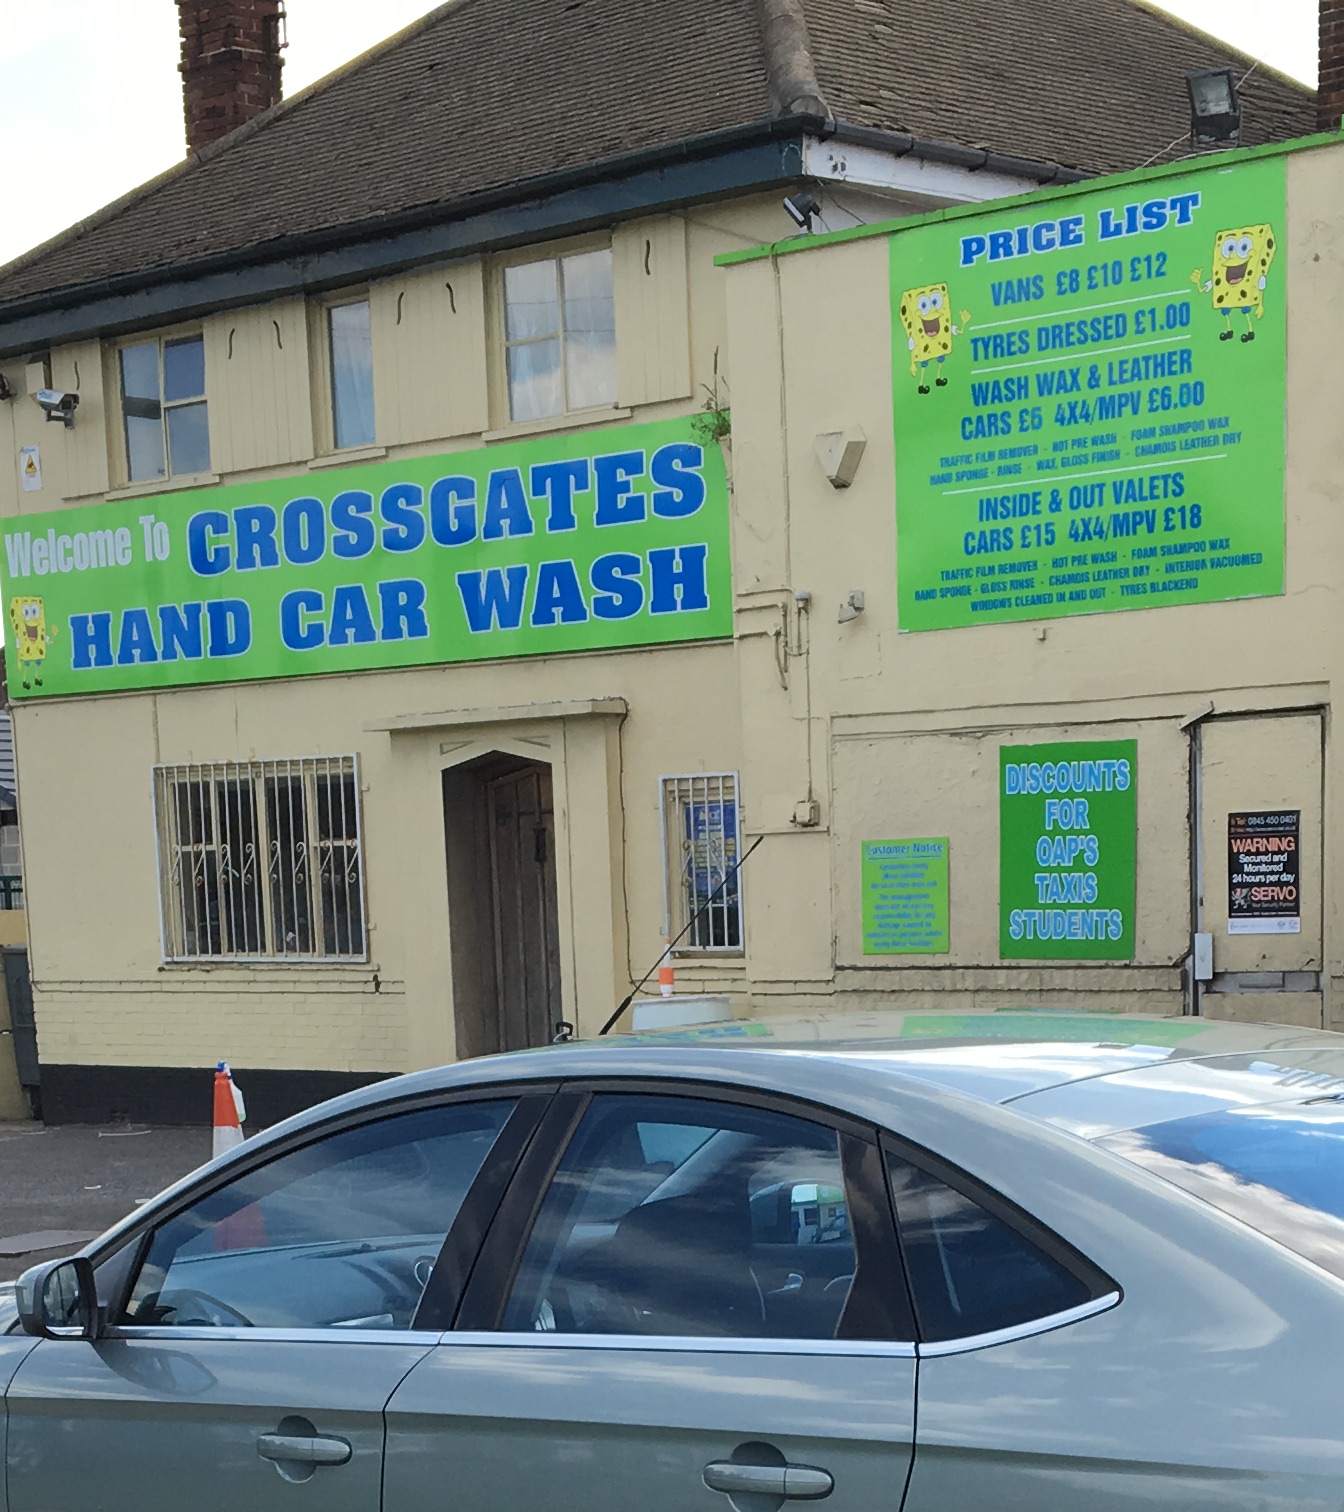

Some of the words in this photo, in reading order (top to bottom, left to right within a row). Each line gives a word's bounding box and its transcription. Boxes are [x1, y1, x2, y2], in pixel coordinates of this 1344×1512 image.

[959, 214, 1085, 267] PRICE
[1098, 191, 1202, 240] LIST
[991, 274, 1044, 306] VANS
[1056, 269, 1080, 297] £8
[1087, 260, 1123, 290] £10
[1130, 252, 1167, 282] £12
[970, 328, 1030, 362] TYRES
[1038, 311, 1127, 350] DRESSED
[1134, 302, 1191, 336] £1.00
[971, 372, 1028, 406] WASH
[1035, 366, 1082, 397] WAX
[1087, 364, 1101, 389] &
[1108, 349, 1193, 387] LEATHER
[961, 410, 1012, 440] CARS
[1054, 389, 1141, 428] 4X4/MPV
[1148, 380, 1205, 414] £6.00
[940, 454, 973, 468] TRAFFIC
[975, 450, 995, 463] FILM
[998, 444, 1038, 460] REMOVER
[1052, 440, 1068, 453] HOT
[1071, 437, 1088, 450] PRE
[1090, 433, 1117, 447] WASH
[1131, 427, 1155, 441] FOAM
[1159, 420, 1204, 437] SHAMPOO
[1208, 416, 1230, 430] WAX
[955, 467, 989, 482] SPONGE
[1061, 454, 1088, 468] GLOSS
[1092, 449, 1120, 464] FINISH
[1135, 441, 1176, 458] CHAMOIS
[1180, 434, 1220, 451] LEATHER
[1223, 432, 1242, 445] DRY
[4, 524, 132, 578] Welcome
[143, 514, 170, 561] To
[187, 442, 706, 577] CROSSGATES
[978, 491, 1042, 522] INSIDE
[1049, 488, 1062, 513] &
[1069, 482, 1105, 512] OUT
[1112, 472, 1185, 505] VALETS
[963, 526, 1014, 556] CARS
[1020, 521, 1056, 548] £15
[1069, 508, 1157, 545] 4X4/MPV
[1163, 504, 1202, 533] £18
[939, 585, 972, 599] SPONGE
[980, 581, 1007, 594] GLOSS
[1010, 578, 1035, 591] RINSE
[1049, 572, 1090, 586] CHAMOIS
[1093, 567, 1130, 582] LEATHER
[1133, 565, 1150, 578] DRY
[1165, 559, 1207, 574] INTERIOR
[1210, 552, 1263, 569] VACUUMED
[941, 568, 974, 581] TRAFFIC
[976, 565, 995, 577] FILM
[998, 560, 1038, 575] REMOVER
[1052, 556, 1068, 568] HOT
[1071, 554, 1088, 566] PRE
[1091, 551, 1117, 564] WASH
[1131, 546, 1158, 560] FOAM
[1160, 541, 1206, 556] SHAMPOO
[1209, 538, 1230, 550] WAX
[69, 597, 252, 670] HAND
[279, 577, 429, 652] CAR
[455, 543, 709, 635] WASH
[971, 598, 1012, 612] WINDOWS
[1015, 593, 1054, 607] CLEANED
[1057, 591, 1066, 602] IN
[1069, 589, 1087, 601] AND
[1090, 587, 1106, 600] OUT
[1120, 583, 1147, 597] TYRES
[1150, 577, 1198, 593] BLACKEND
[1005, 758, 1131, 795] DISCOUNTS
[1045, 797, 1089, 831] FOR
[1035, 835, 1100, 868] OAP'S
[1231, 836, 1296, 853] WARNING
[1239, 853, 1272, 864] Secured
[1272, 852, 1288, 862] and
[1034, 872, 1098, 905] TAXIS
[1232, 873, 1243, 883] 24
[1243, 872, 1265, 883] hours
[1266, 874, 1279, 884] per
[1280, 872, 1296, 884] day
[1243, 862, 1284, 873] Monitored
[1251, 886, 1296, 901] SERVO
[1009, 908, 1123, 941] STUDENTS
